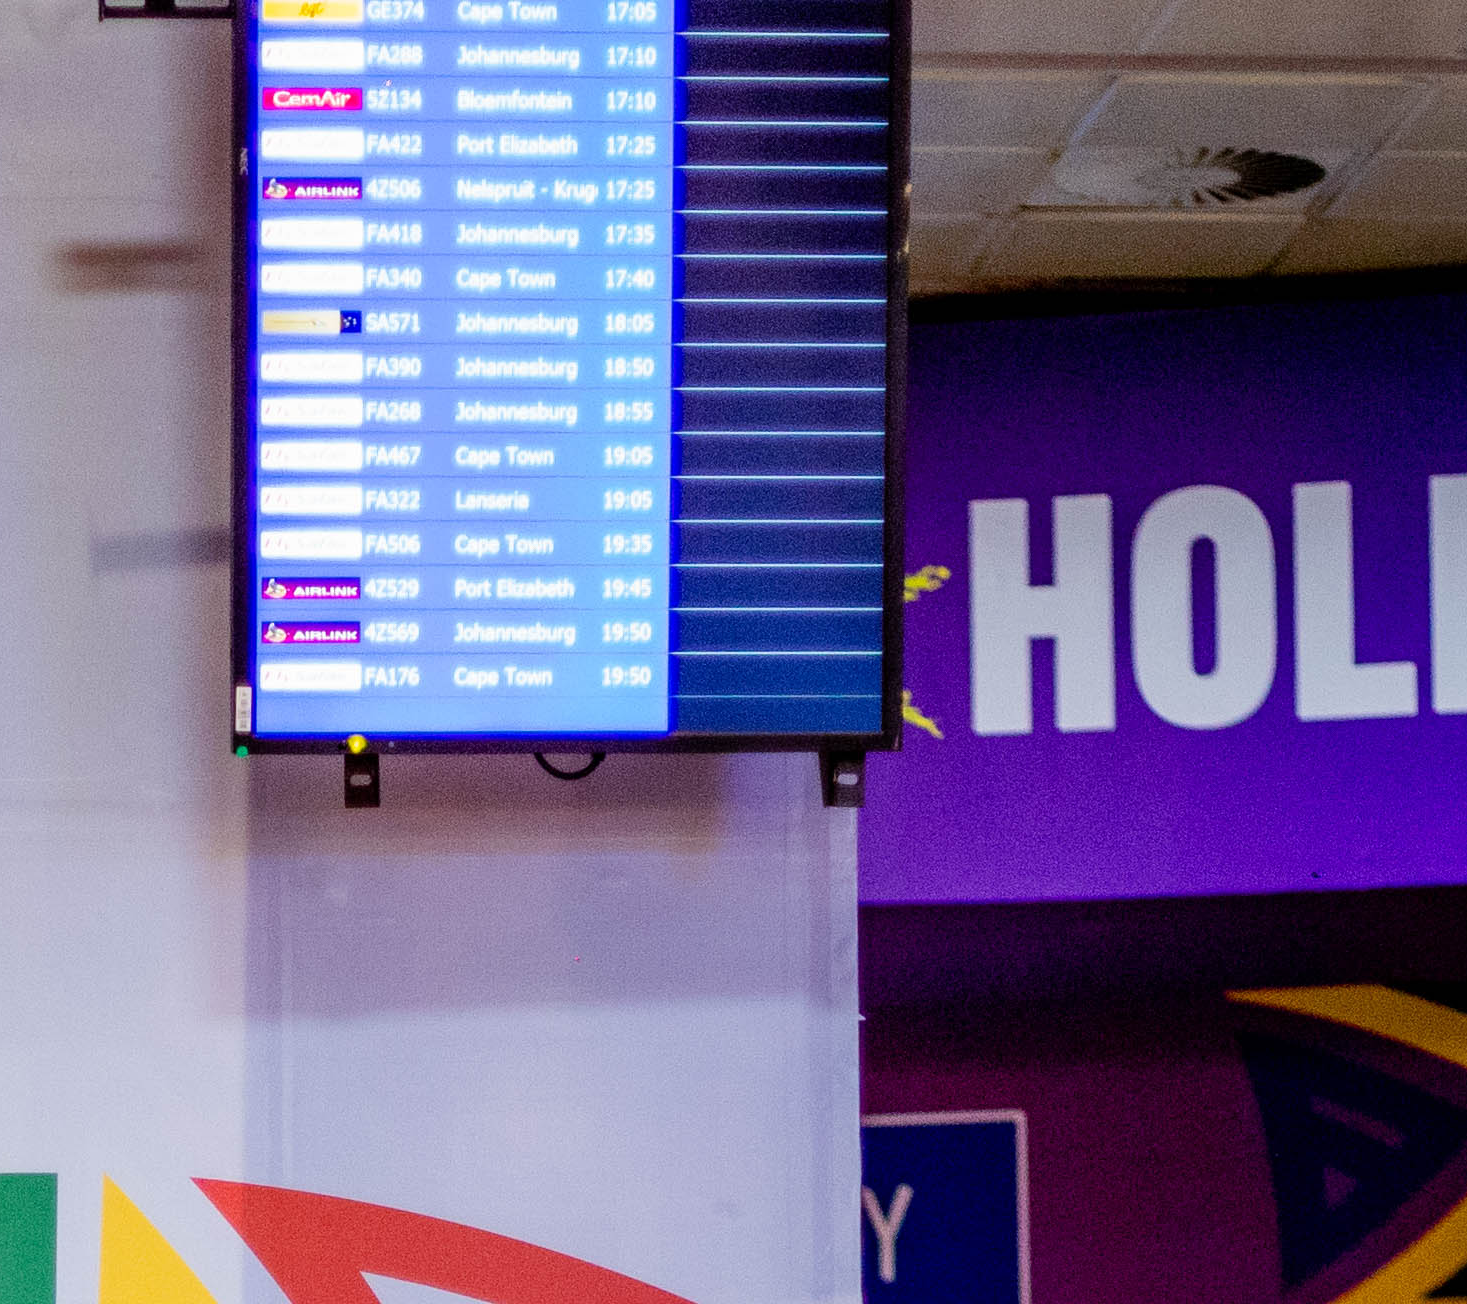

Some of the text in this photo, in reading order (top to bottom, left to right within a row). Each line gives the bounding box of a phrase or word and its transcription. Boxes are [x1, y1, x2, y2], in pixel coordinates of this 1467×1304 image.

[365, 0, 425, 21] GE374
[457, 0, 504, 24] Cape
[508, 0, 558, 21] Town
[608, 1, 657, 22] 17:05
[457, 45, 580, 70] Johannesburg
[608, 46, 657, 67] 17:10
[272, 90, 351, 108] CemAir
[457, 89, 573, 111] Bloemfontein
[608, 91, 657, 111] 17:10
[365, 133, 656, 156] FA422 Port Elizabeth 17:25
[294, 185, 360, 198] AIRLINK
[365, 178, 422, 200] 4Z506
[456, 179, 535, 203] Nelspruit
[607, 179, 655, 200] 17:25
[364, 223, 655, 248] FA418 Johannesburg 17:35
[364, 267, 655, 292] FA340 Cape Town 17:40
[365, 312, 655, 337] SA571 Johannesburg 18:05
[363, 356, 655, 382] FA390 Johannesburg 18:50
[455, 401, 578, 426] Johannesburg
[605, 401, 654, 422] 18:55
[363, 445, 654, 469] FA467 Cape Town 19:05
[363, 489, 653, 511] FA322 Lanseria 19:05
[363, 533, 653, 558] FA506 Cape Town 19:35
[292, 577, 652, 599] AIRLINK 4Z529 Port Elizabeth 19:45
[292, 621, 652, 646] AIRLINK 4Z569 Johannesburg 19:50
[362, 665, 652, 690] FA176 Cape Town 19:50
